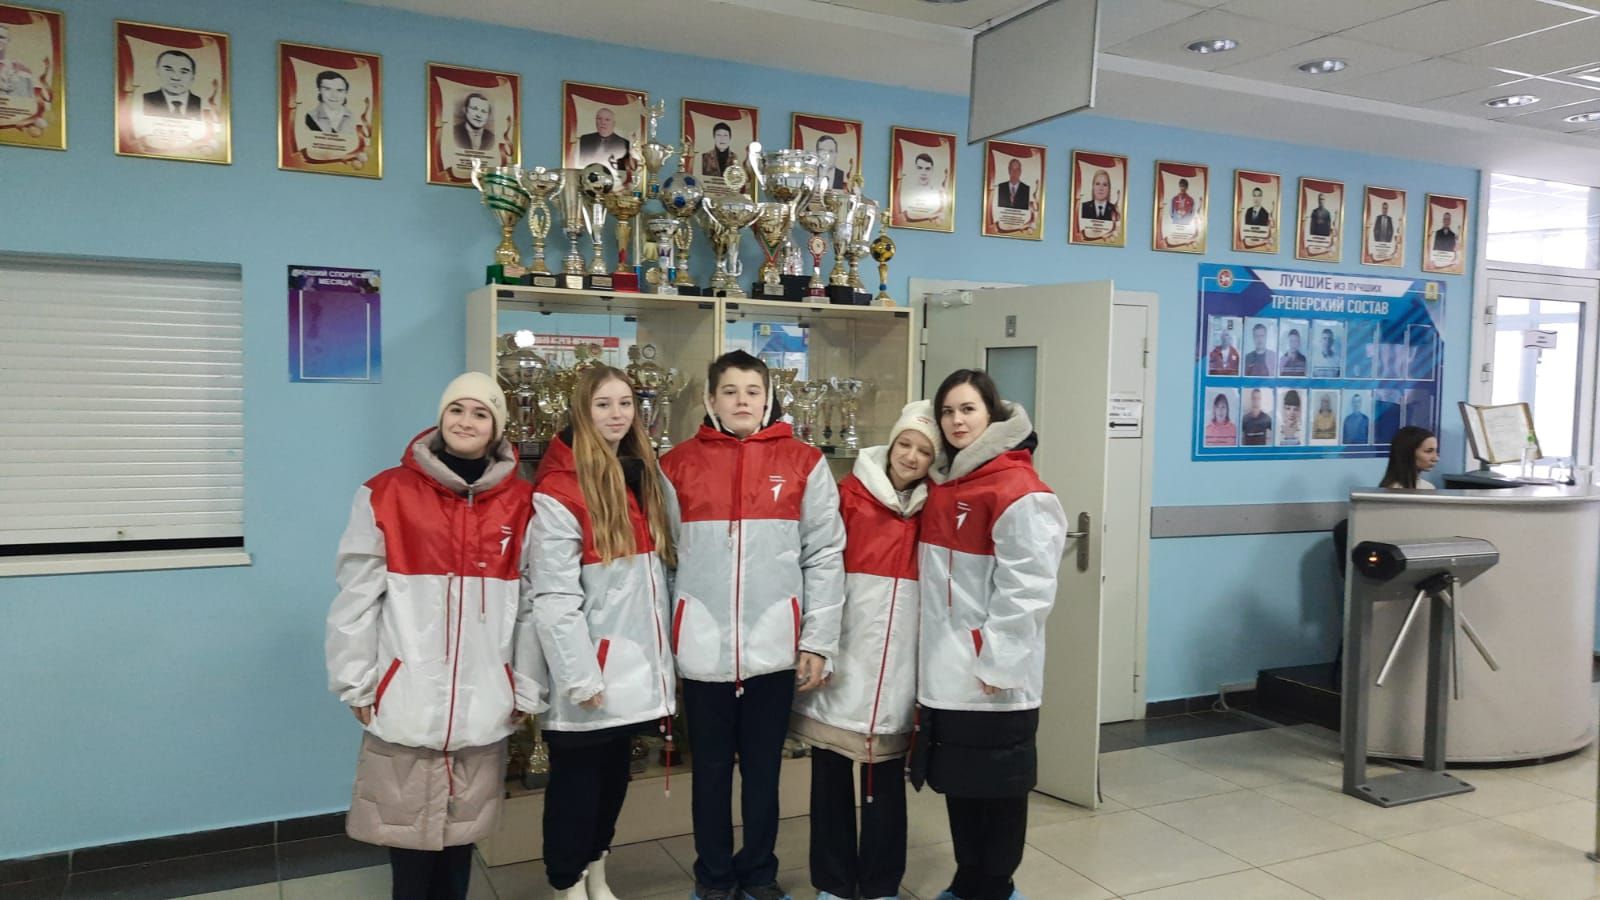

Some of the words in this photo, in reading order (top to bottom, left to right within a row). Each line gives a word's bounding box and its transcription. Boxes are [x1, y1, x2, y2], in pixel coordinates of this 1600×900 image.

[1280, 273, 1333, 290] ЛУЧШИЕ
[1271, 294, 1344, 313] ТРЕНЕРСКИЙ
[1347, 299, 1390, 315] СОСТАВ
